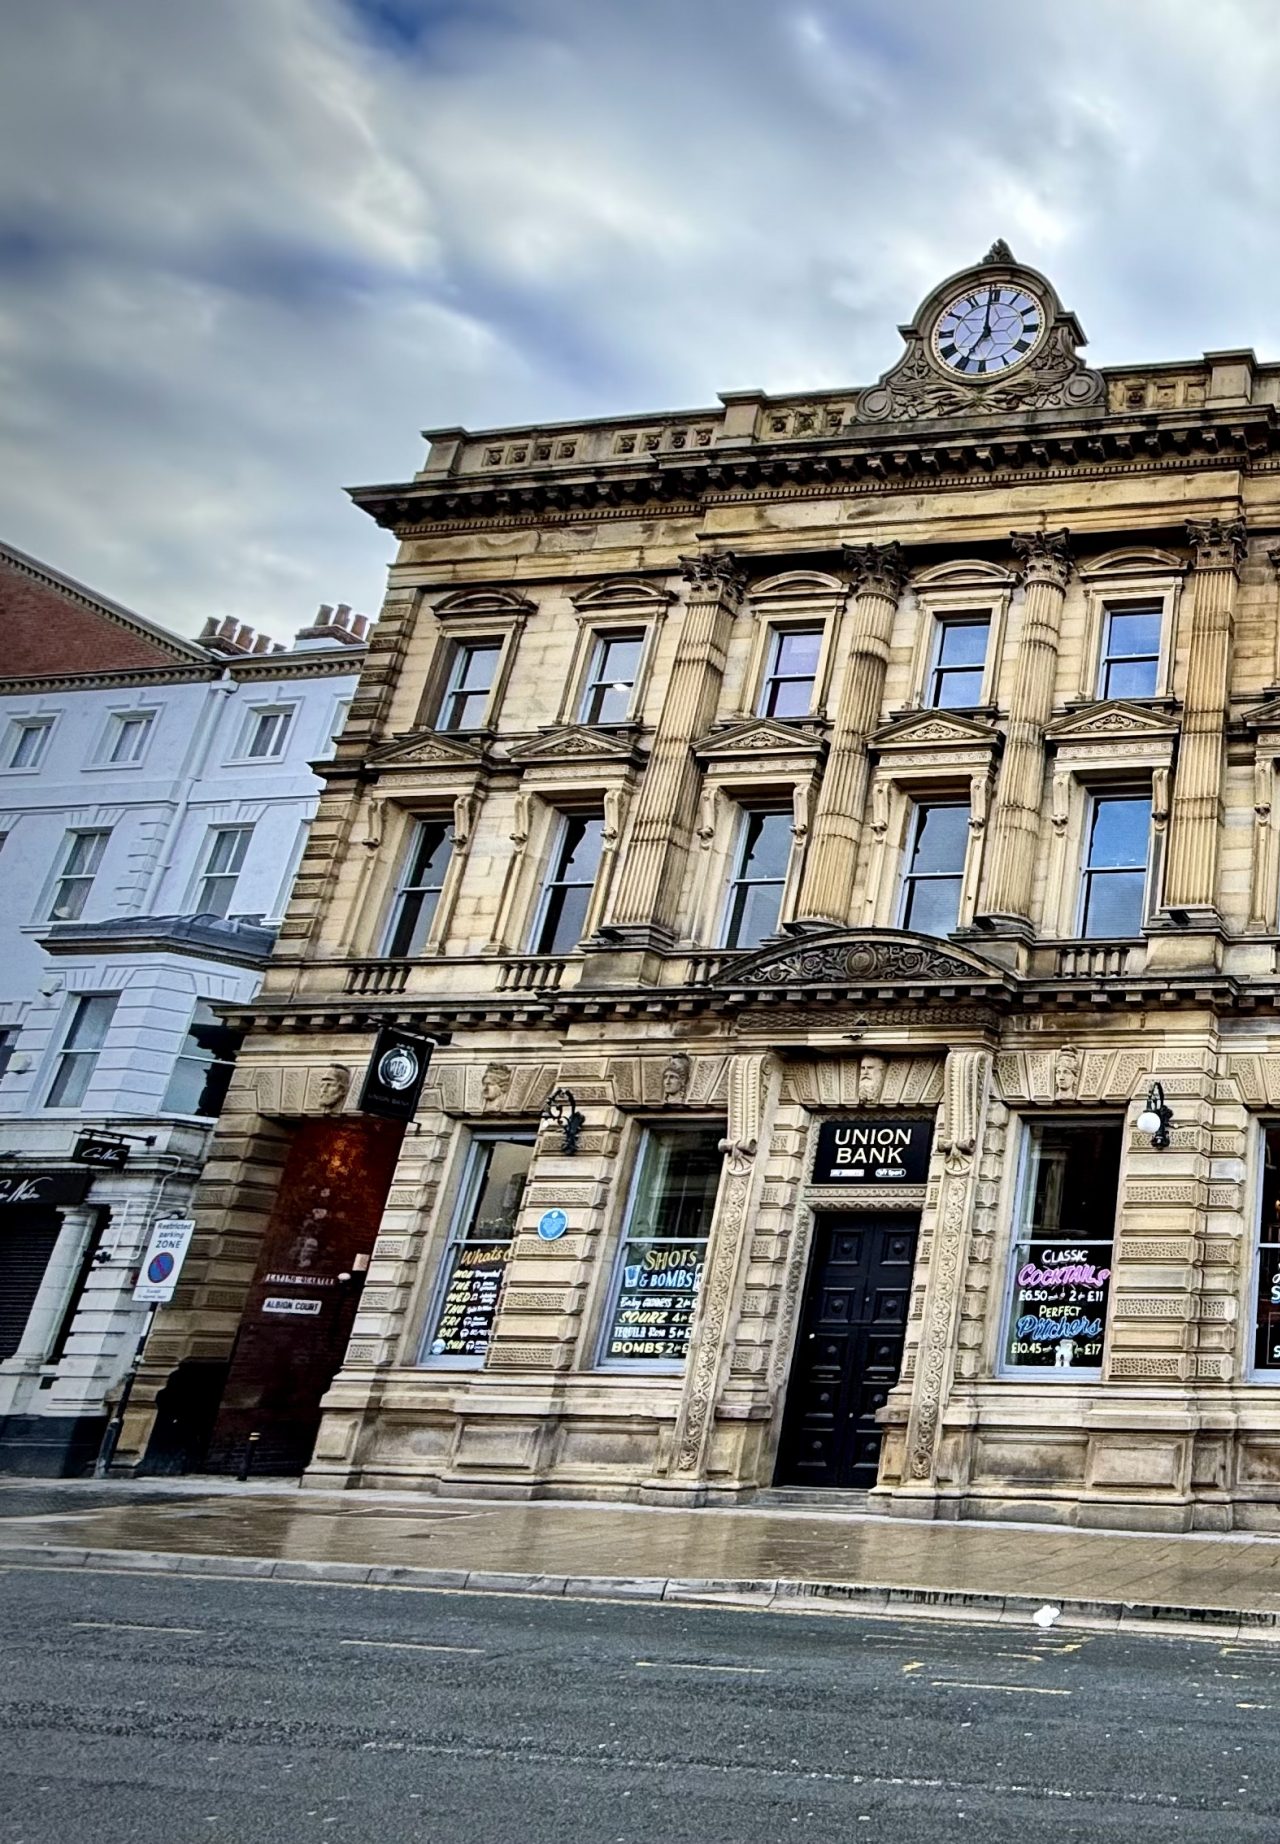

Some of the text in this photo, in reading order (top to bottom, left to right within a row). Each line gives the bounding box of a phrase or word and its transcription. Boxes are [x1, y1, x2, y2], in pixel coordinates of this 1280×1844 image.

[834, 1128, 912, 1145] UNION
[836, 1147, 904, 1164] BANK
[155, 1240, 182, 1248] ZONE
[642, 1249, 698, 1271] SHOTS
[1041, 1249, 1089, 1263] CLASSIC
[639, 1270, 694, 1288] & BOMBS
[450, 1281, 471, 1291] TUE
[446, 1292, 471, 1302] WED
[1019, 1289, 1048, 1301] £6.50
[1069, 1290, 1077, 1302] 2
[1087, 1290, 1104, 1302] £11
[295, 1303, 319, 1311] COURT
[675, 1297, 683, 1308] 2
[619, 1311, 668, 1324] SOURZ
[672, 1312, 680, 1323] 4
[1039, 1304, 1082, 1318] PERFECT
[440, 1316, 461, 1326] FRI
[1017, 1315, 1102, 1340] Pitchers
[437, 1328, 458, 1338] SAT
[614, 1326, 646, 1338] TEQUILA
[668, 1327, 677, 1338] 5
[611, 1341, 665, 1353] BOMBS
[665, 1343, 674, 1354] 2
[1011, 1342, 1042, 1354] £10.45
[1084, 1343, 1102, 1355] £17
